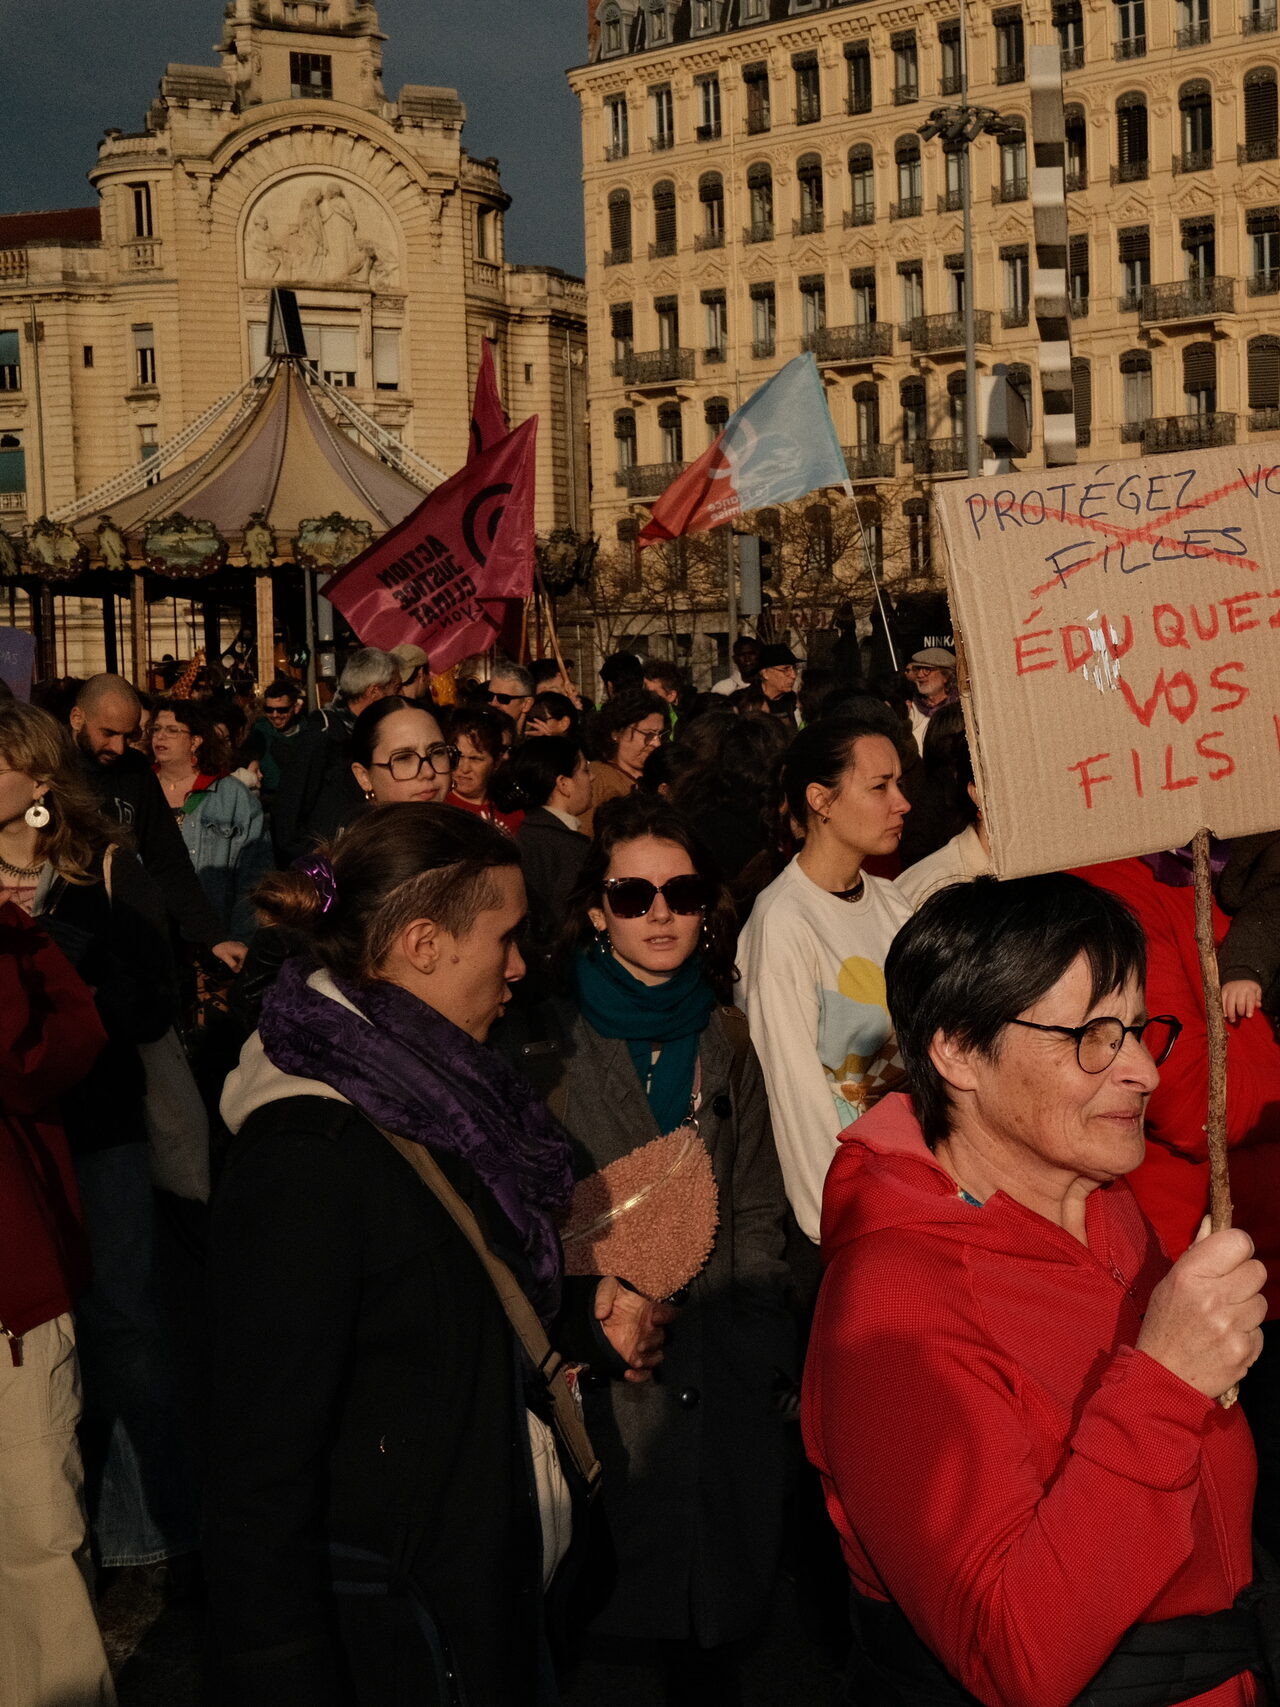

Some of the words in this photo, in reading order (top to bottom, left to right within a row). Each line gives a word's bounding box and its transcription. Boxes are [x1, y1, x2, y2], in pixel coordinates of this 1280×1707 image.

[965, 464, 1206, 540] PROTÉGEZ
[1116, 661, 1250, 728] VOS
[1067, 731, 1237, 809] FILS
